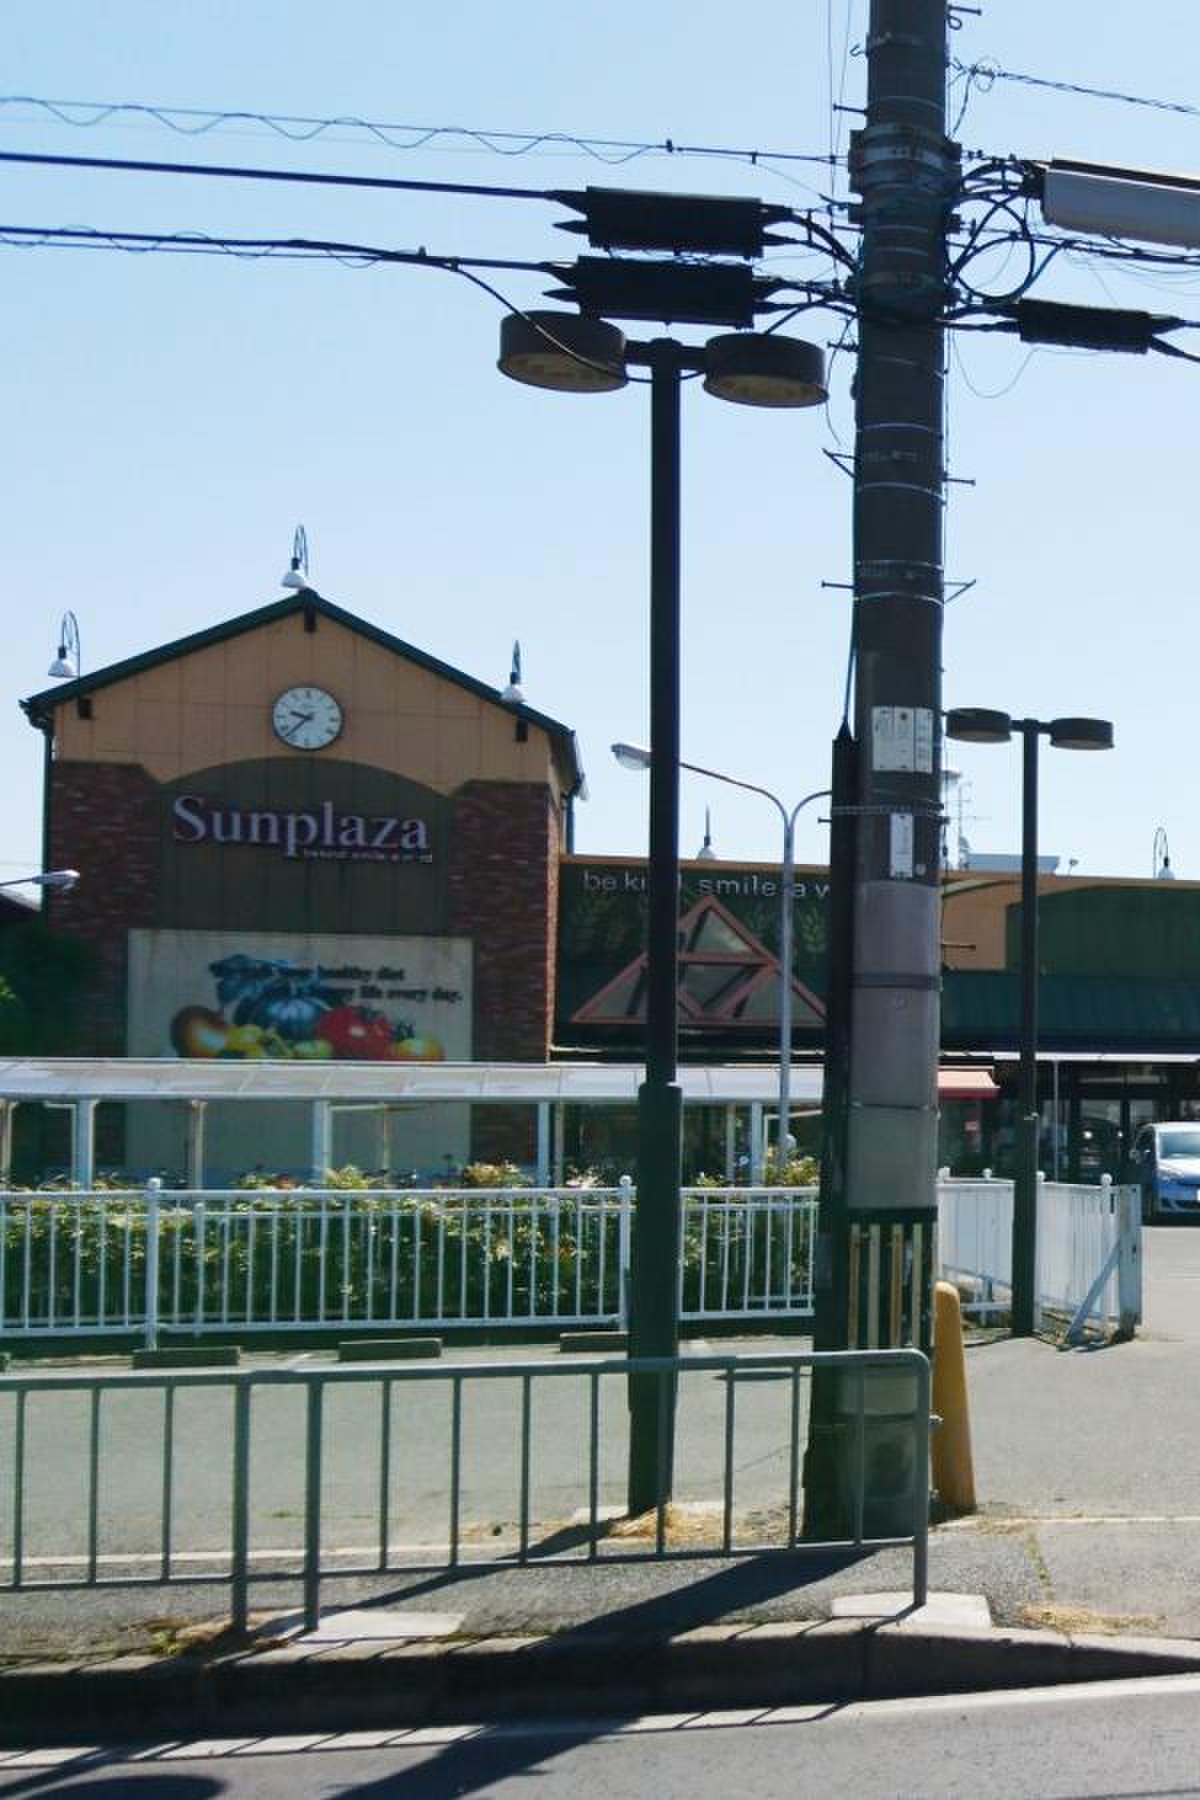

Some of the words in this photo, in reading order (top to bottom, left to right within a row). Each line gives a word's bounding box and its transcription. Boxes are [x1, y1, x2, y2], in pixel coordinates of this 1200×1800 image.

[172, 795, 430, 858] Sunplaza
[583, 870, 617, 892] be
[699, 874, 777, 898] smile
